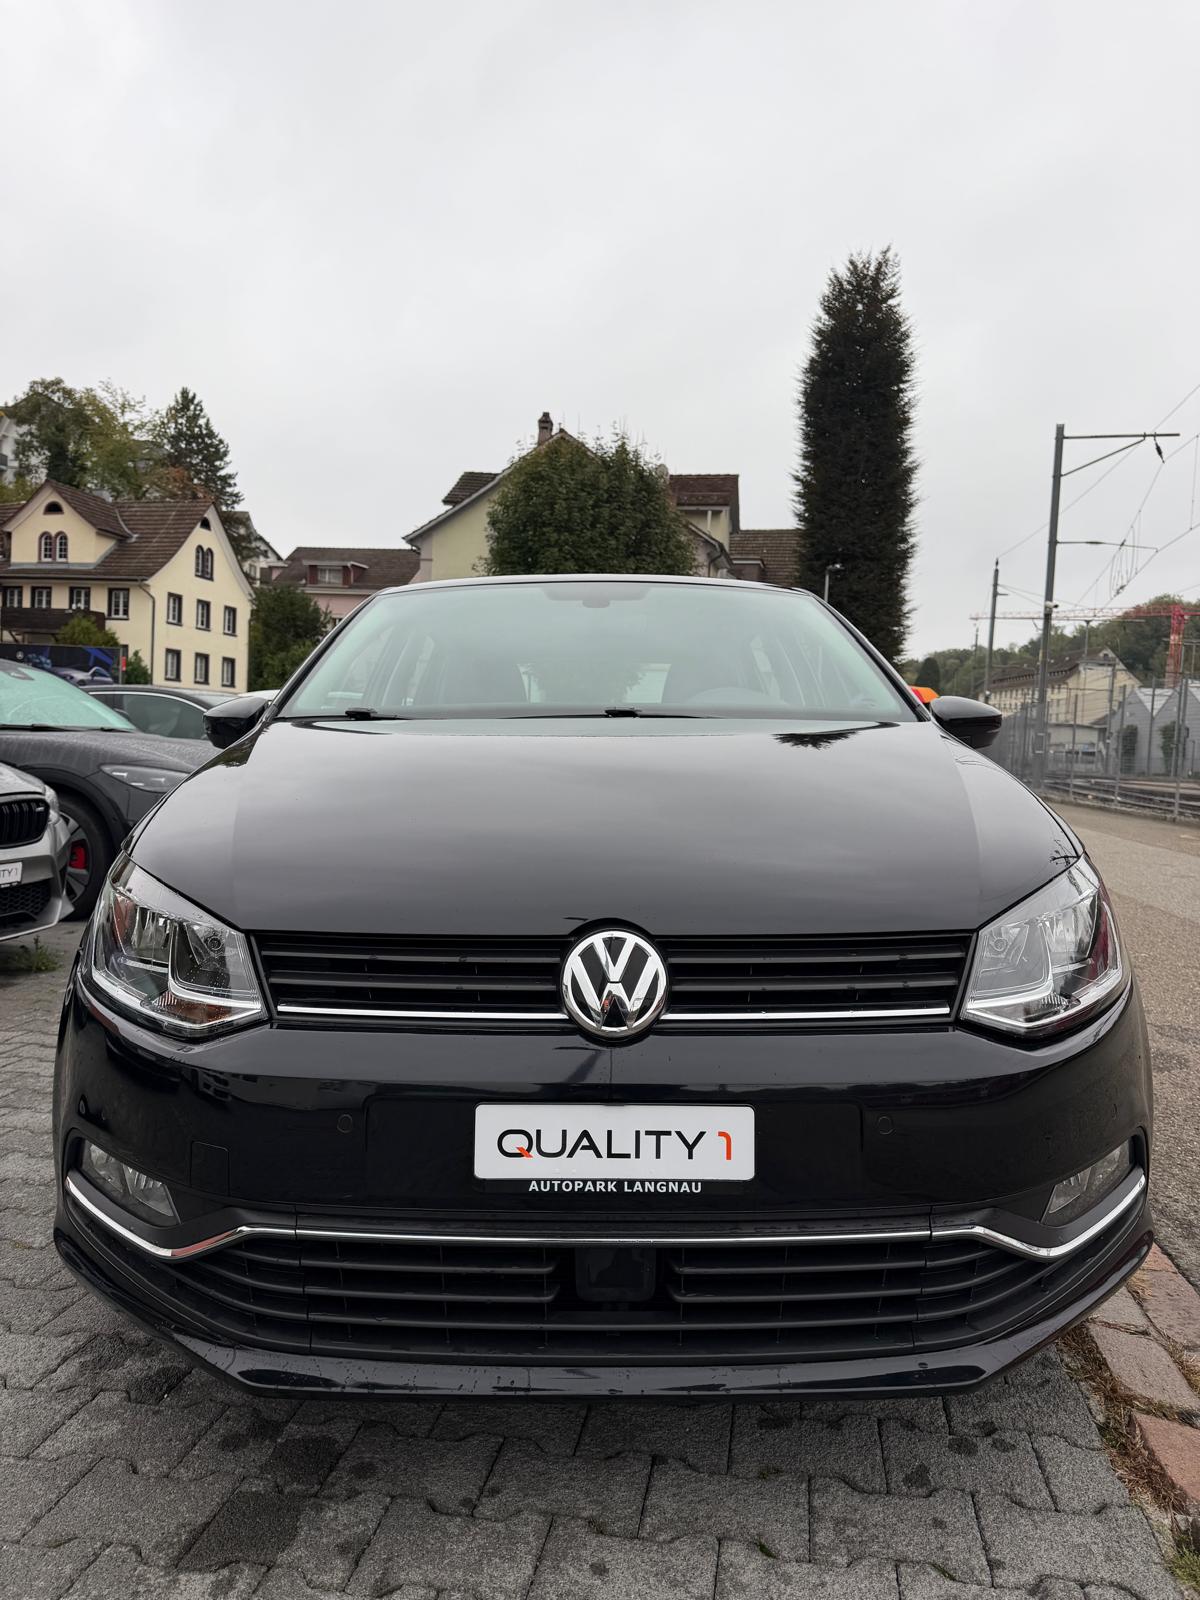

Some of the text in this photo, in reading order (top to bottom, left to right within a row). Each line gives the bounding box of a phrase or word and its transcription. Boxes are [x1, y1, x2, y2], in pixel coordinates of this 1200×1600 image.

[497, 1129, 732, 1160] QUALITY 1
[528, 1180, 702, 1193] AUTOPARK LANGNAU
